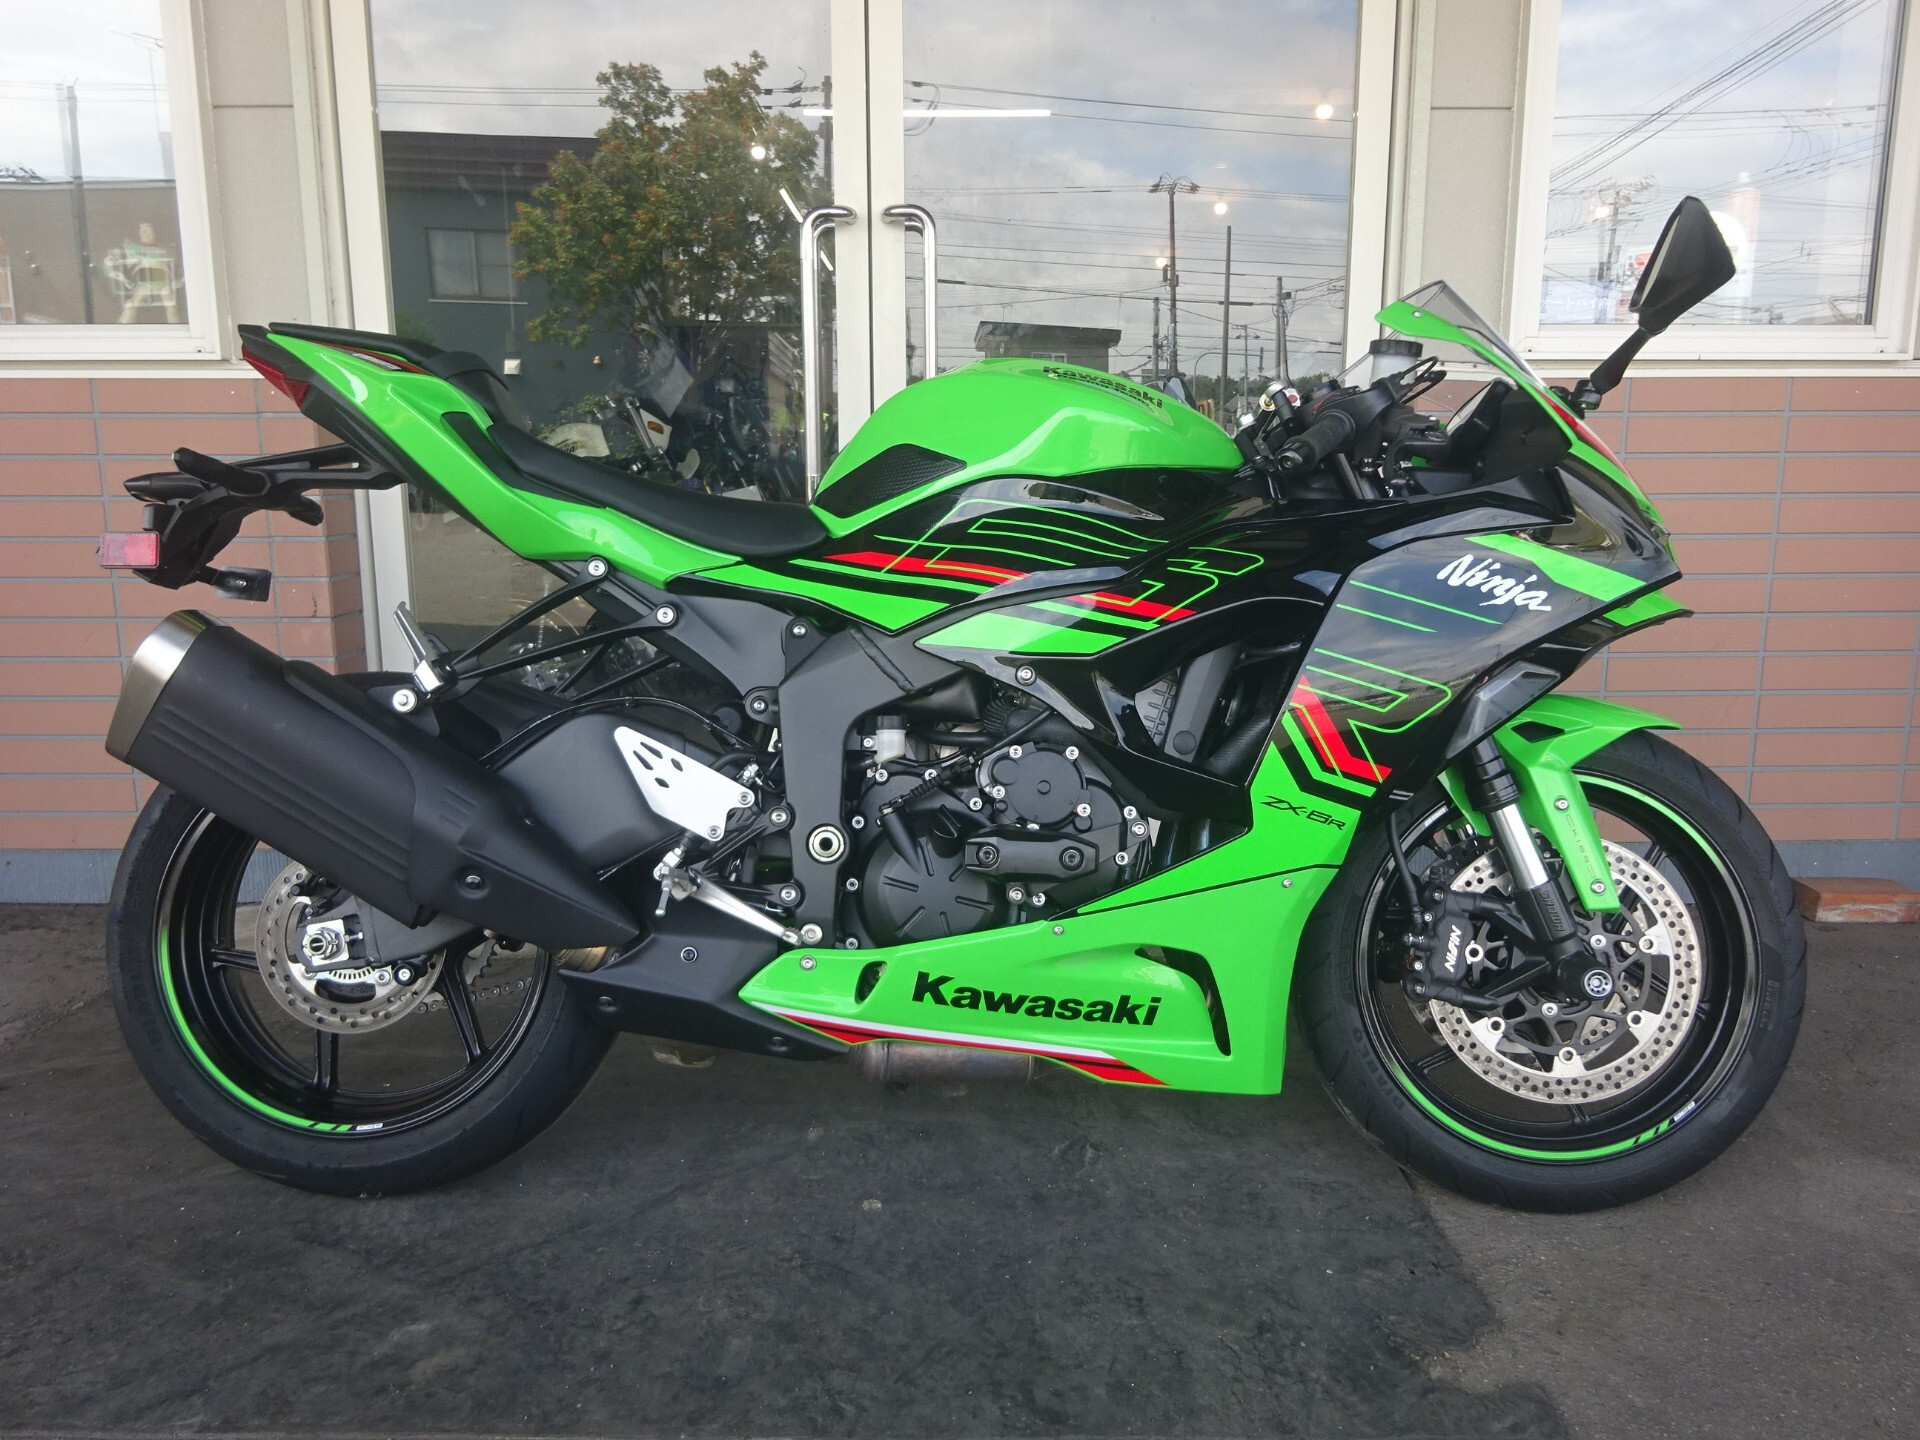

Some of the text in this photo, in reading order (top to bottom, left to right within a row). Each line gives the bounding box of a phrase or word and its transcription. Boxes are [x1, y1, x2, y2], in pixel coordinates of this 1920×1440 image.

[1043, 366, 1163, 408] Kawasaki
[1436, 553, 1552, 612] Ninja
[1260, 795, 1346, 831] ZX-6R
[1539, 890, 1566, 932] SHOWA
[912, 971, 1162, 1026] Kawasaki
